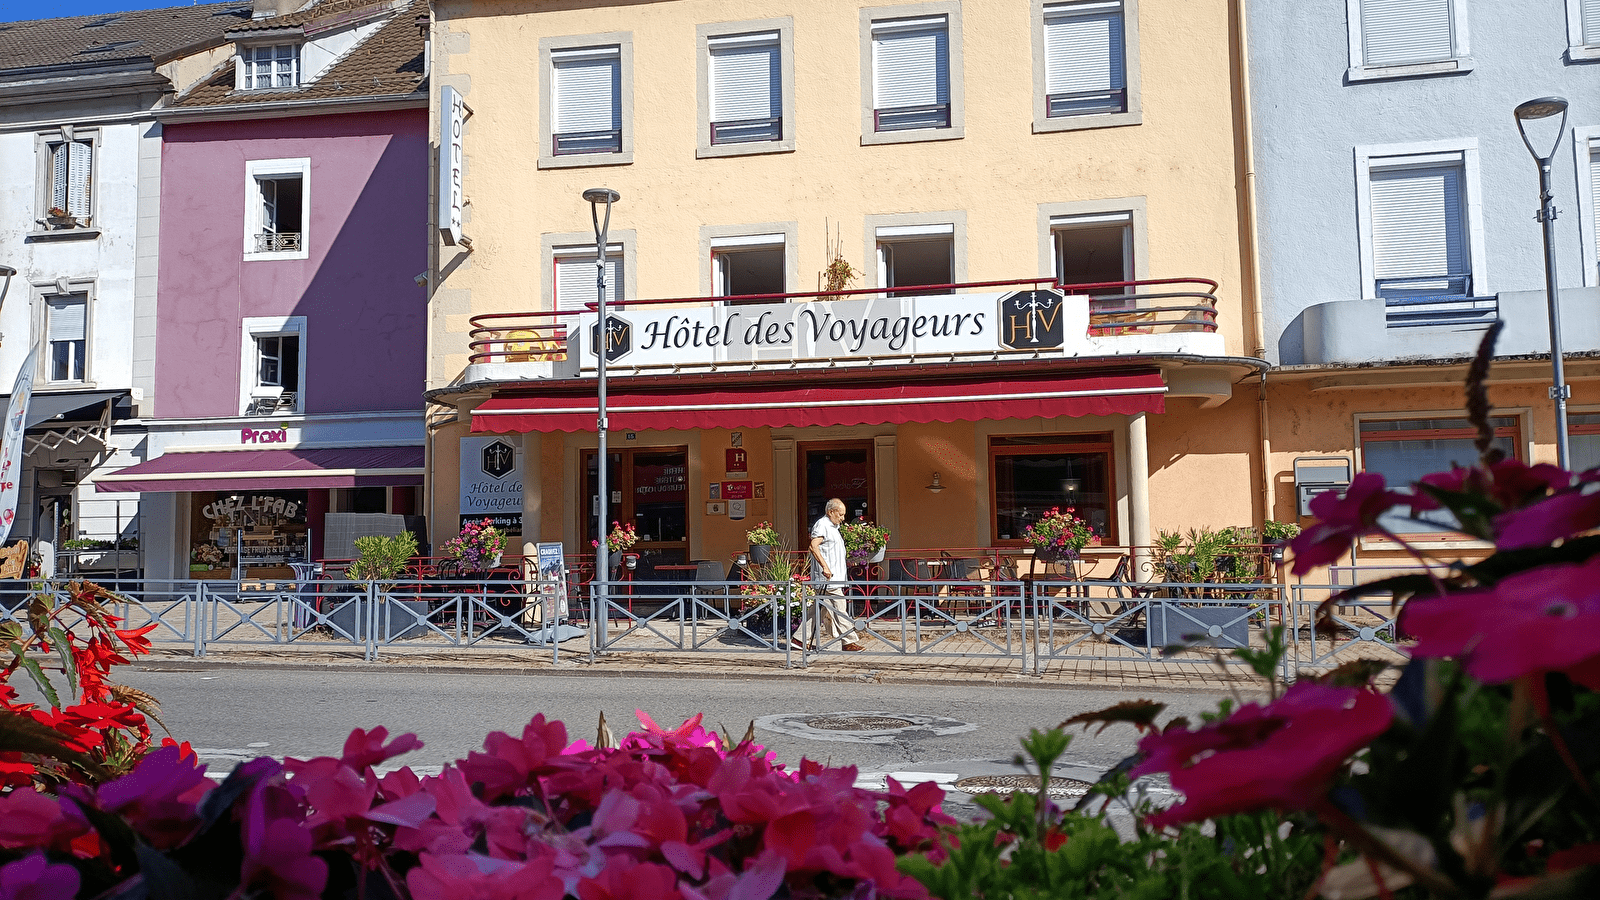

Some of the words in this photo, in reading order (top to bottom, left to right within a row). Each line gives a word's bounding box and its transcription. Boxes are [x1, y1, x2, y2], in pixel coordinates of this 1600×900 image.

[452, 94, 462, 212] HOTEL
[640, 312, 741, 351] Hôtel
[743, 310, 795, 347] des
[800, 309, 985, 352] Voyageurs
[241, 422, 288, 444] Proxi
[735, 453, 745, 462] H
[469, 481, 508, 494] Hôtel
[202, 496, 245, 519] CHEZ
[251, 496, 298, 518] L'FAB
